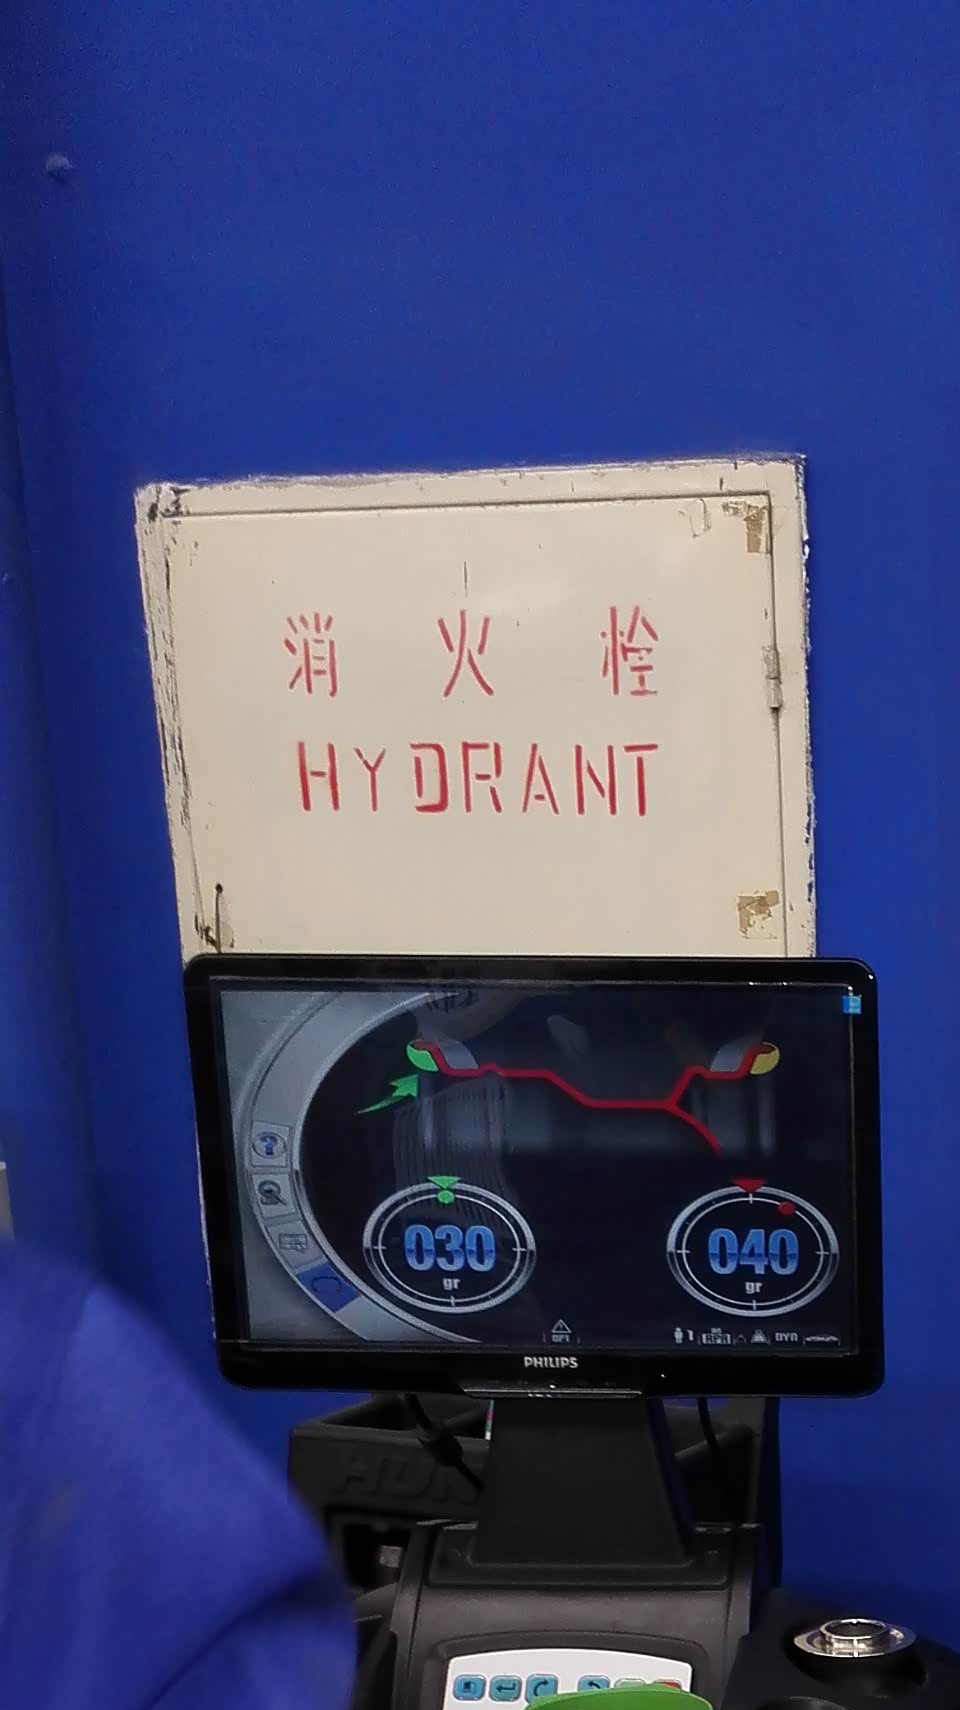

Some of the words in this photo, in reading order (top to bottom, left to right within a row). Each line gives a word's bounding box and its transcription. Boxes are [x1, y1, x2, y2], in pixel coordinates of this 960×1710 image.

[284, 606, 659, 698] 消火栓
[296, 741, 659, 817] HYDRANT
[404, 1224, 496, 1272] 030
[708, 1228, 800, 1275] 040
[443, 1278, 461, 1292] gr
[745, 1281, 763, 1295] gr
[523, 1356, 579, 1369] PHILIPS
